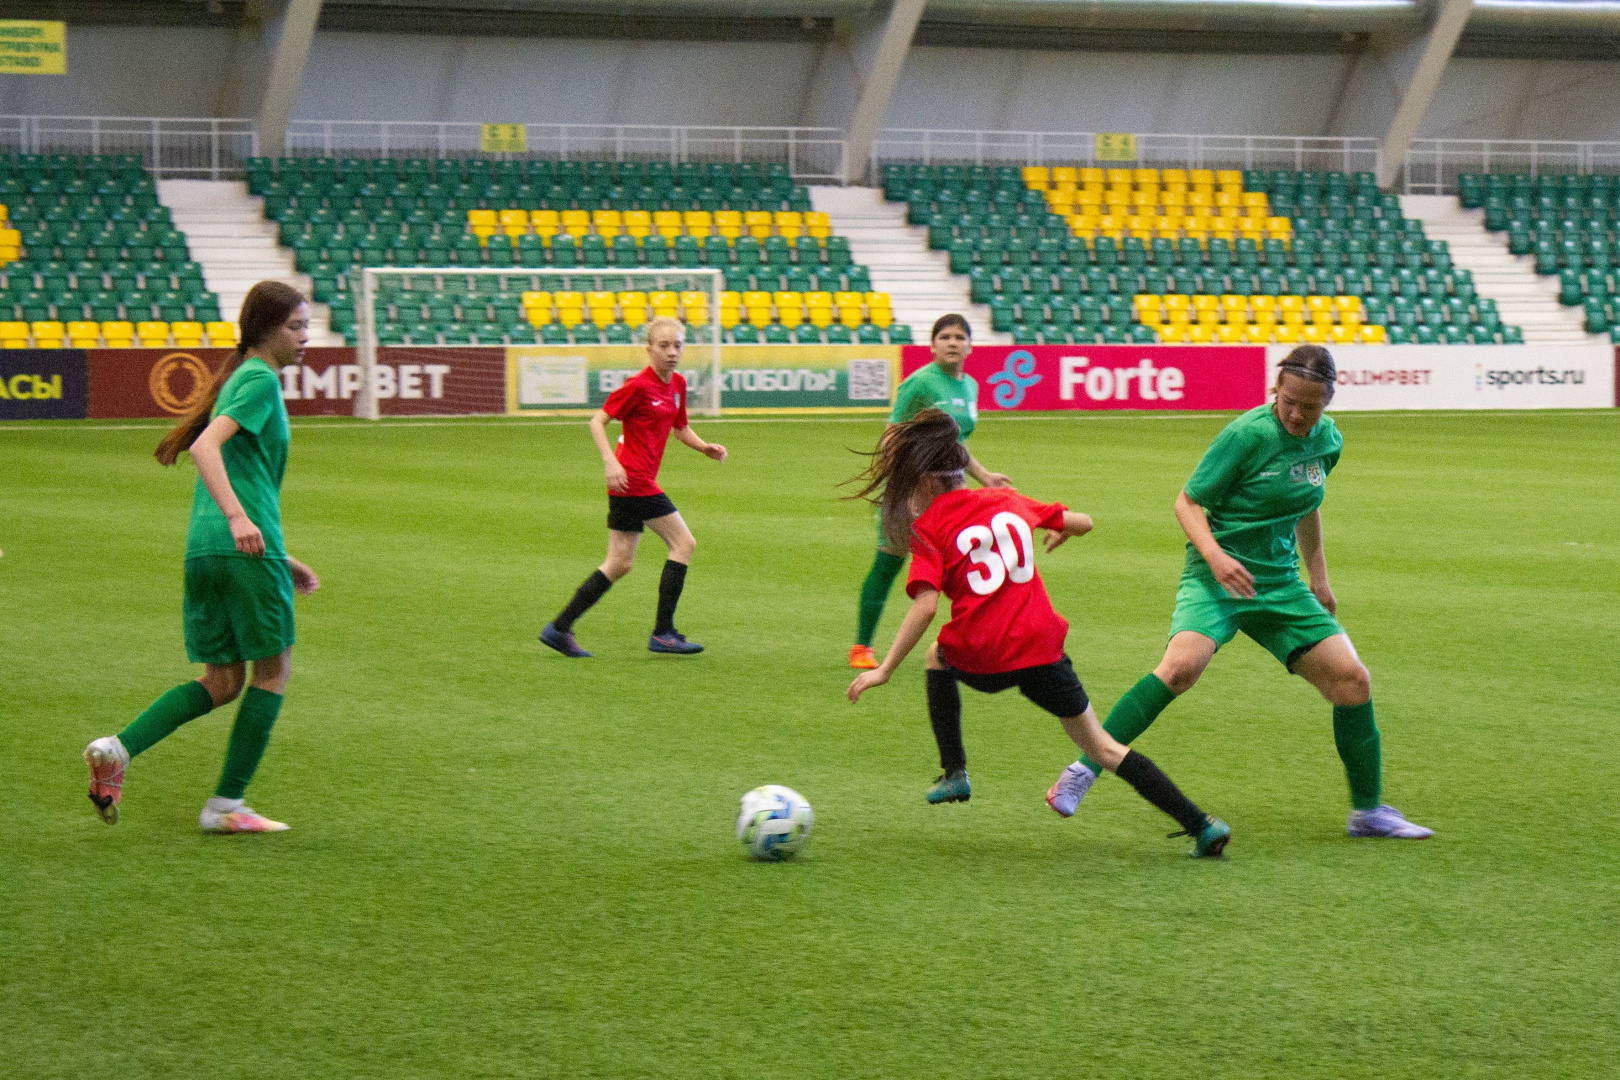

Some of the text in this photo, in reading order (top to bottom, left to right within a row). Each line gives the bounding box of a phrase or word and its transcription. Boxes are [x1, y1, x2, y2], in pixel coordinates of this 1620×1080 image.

[1059, 356, 1185, 401] Forte
[1336, 369, 1431, 386] OLIMPBET
[1486, 365, 1586, 391] sports.ru
[956, 511, 1035, 596] 30
